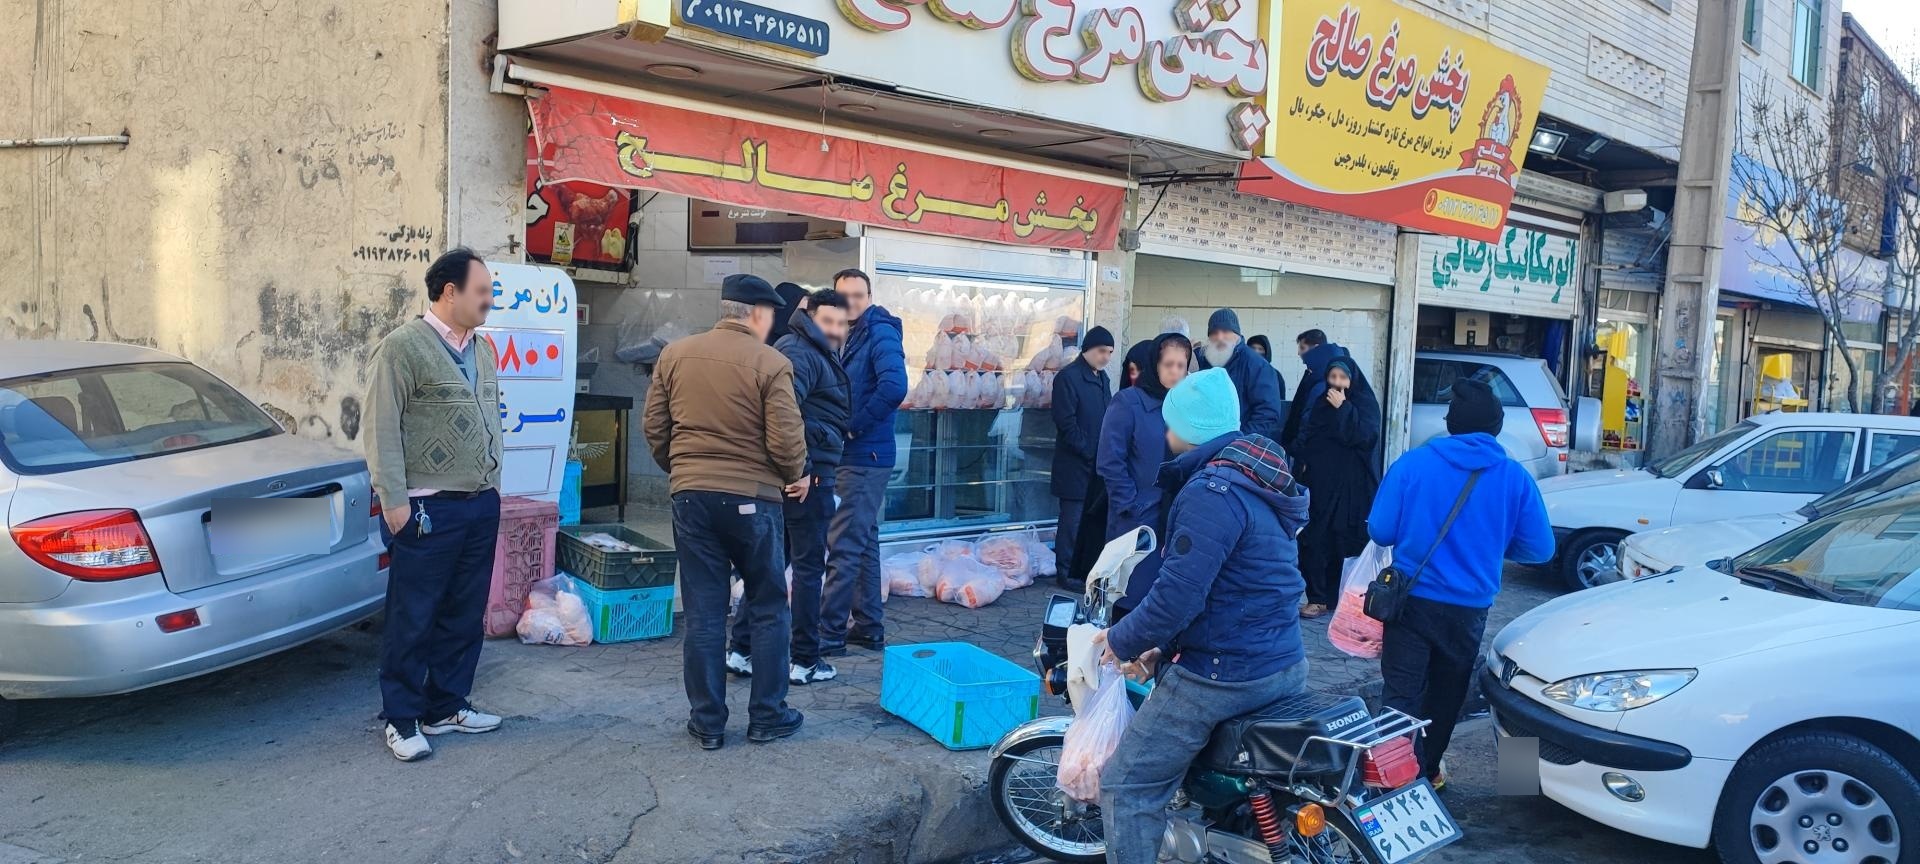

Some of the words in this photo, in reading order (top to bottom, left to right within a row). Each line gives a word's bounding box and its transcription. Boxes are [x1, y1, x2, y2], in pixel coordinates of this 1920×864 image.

[704, 3, 823, 47] ۰۹۱۲-۳۶۱۶۵۱۱
[1306, 3, 1374, 87] صالح
[1366, 18, 1417, 111] مرغ
[1289, 96, 1304, 117] بال
[1411, 47, 1471, 134] پخش
[1384, 127, 1399, 144] تازه
[1399, 128, 1414, 148] مرغ
[1414, 135, 1433, 153] انواع
[1477, 143, 1506, 160] صالح
[615, 130, 874, 201] صالح
[881, 161, 1010, 224] مرغ
[417, 225, 433, 244] لوله
[535, 282, 568, 313] ران
[1326, 709, 1369, 732] HONDA
[1383, 789, 1424, 822] ۳۲۴
[1379, 813, 1451, 861] ۶۱۹۹۸
